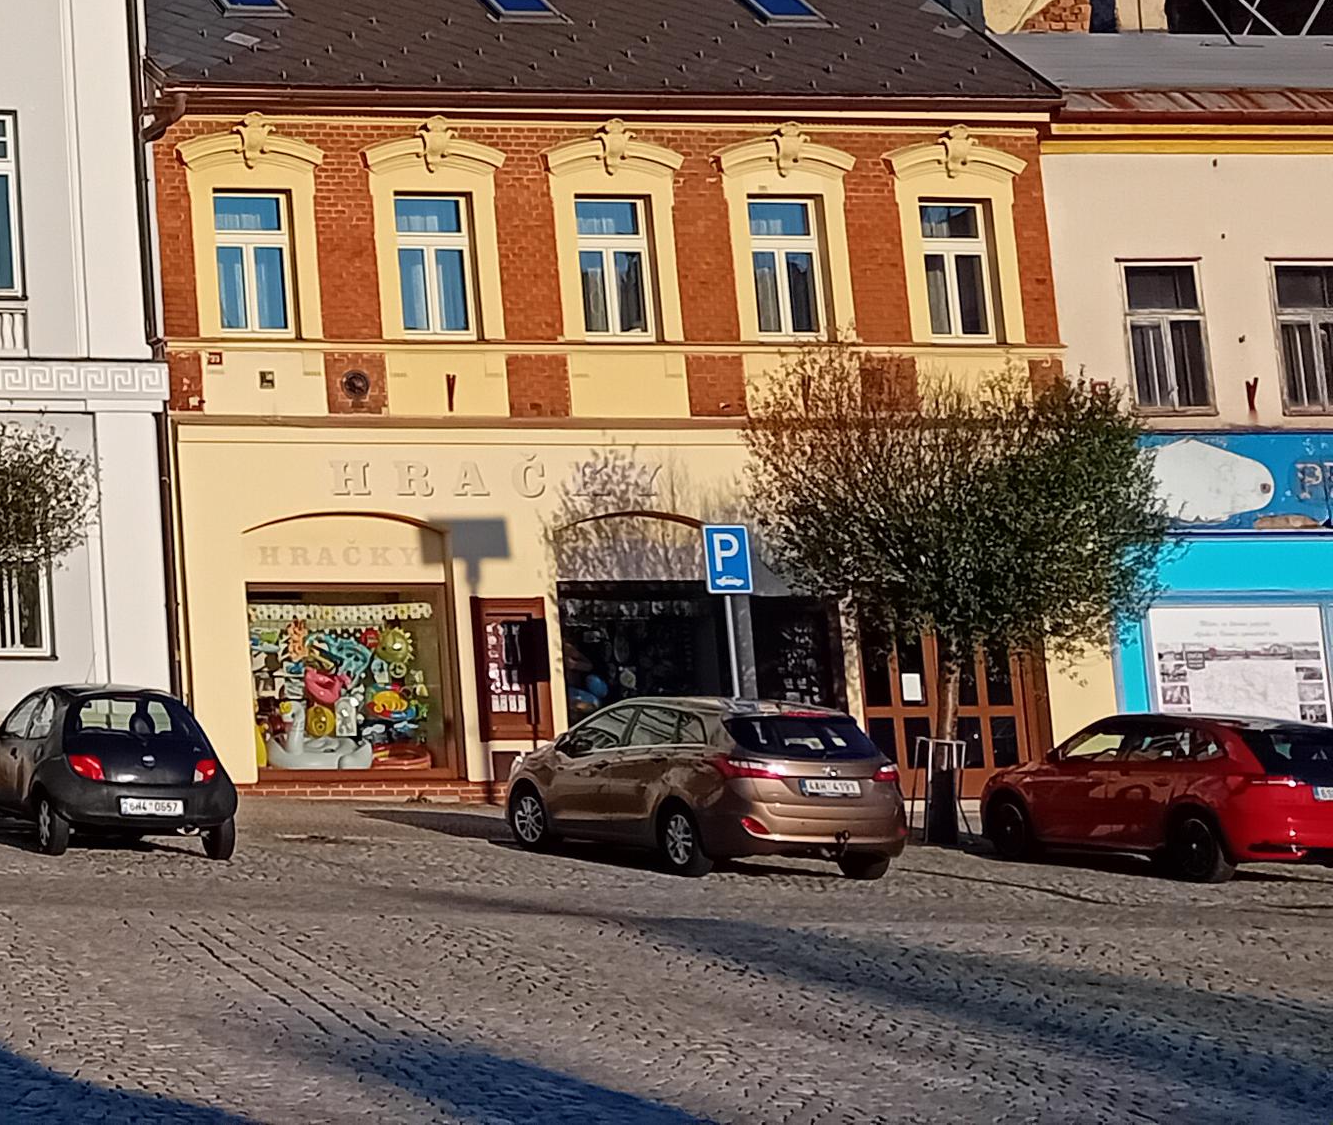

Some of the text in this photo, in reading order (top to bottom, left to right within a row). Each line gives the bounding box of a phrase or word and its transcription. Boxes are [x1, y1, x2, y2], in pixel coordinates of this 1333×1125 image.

[329, 453, 663, 498] HRAČKY
[258, 539, 420, 567] HRAČKY
[713, 533, 739, 572] P
